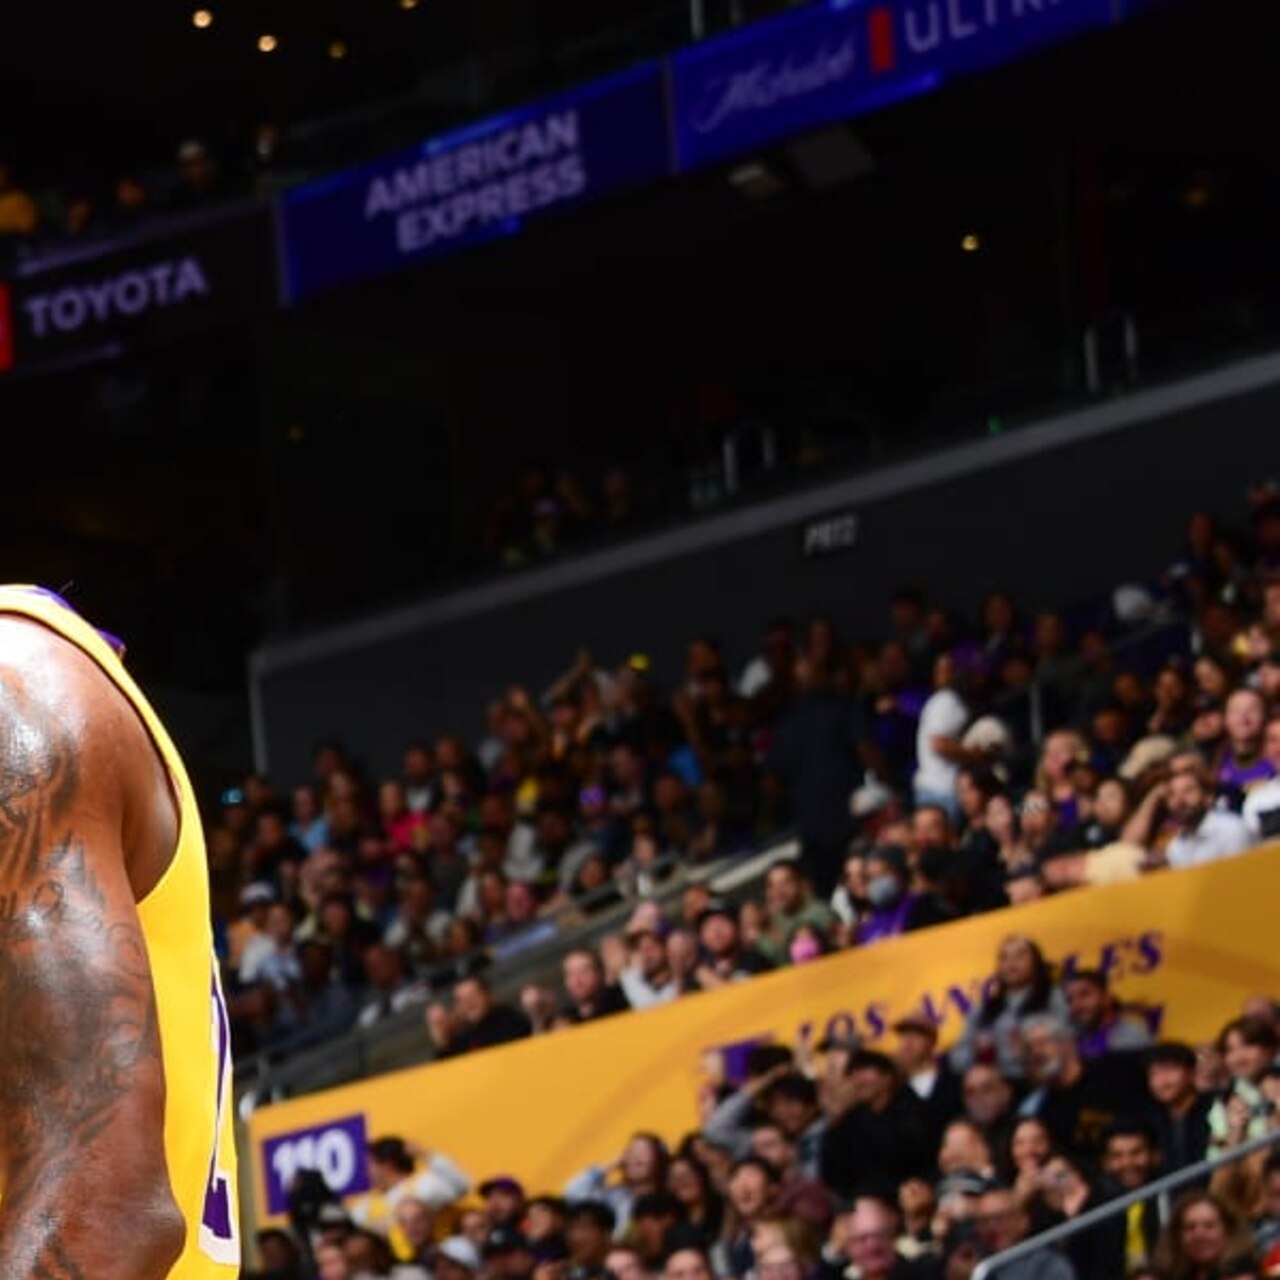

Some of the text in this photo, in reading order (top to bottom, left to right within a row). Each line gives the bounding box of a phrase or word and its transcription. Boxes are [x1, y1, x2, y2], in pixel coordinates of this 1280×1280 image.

[362, 106, 581, 224] AMERICAN
[394, 150, 588, 253] EXPRESS
[25, 254, 211, 338] TOYOTA
[272, 1128, 356, 1194] 110
